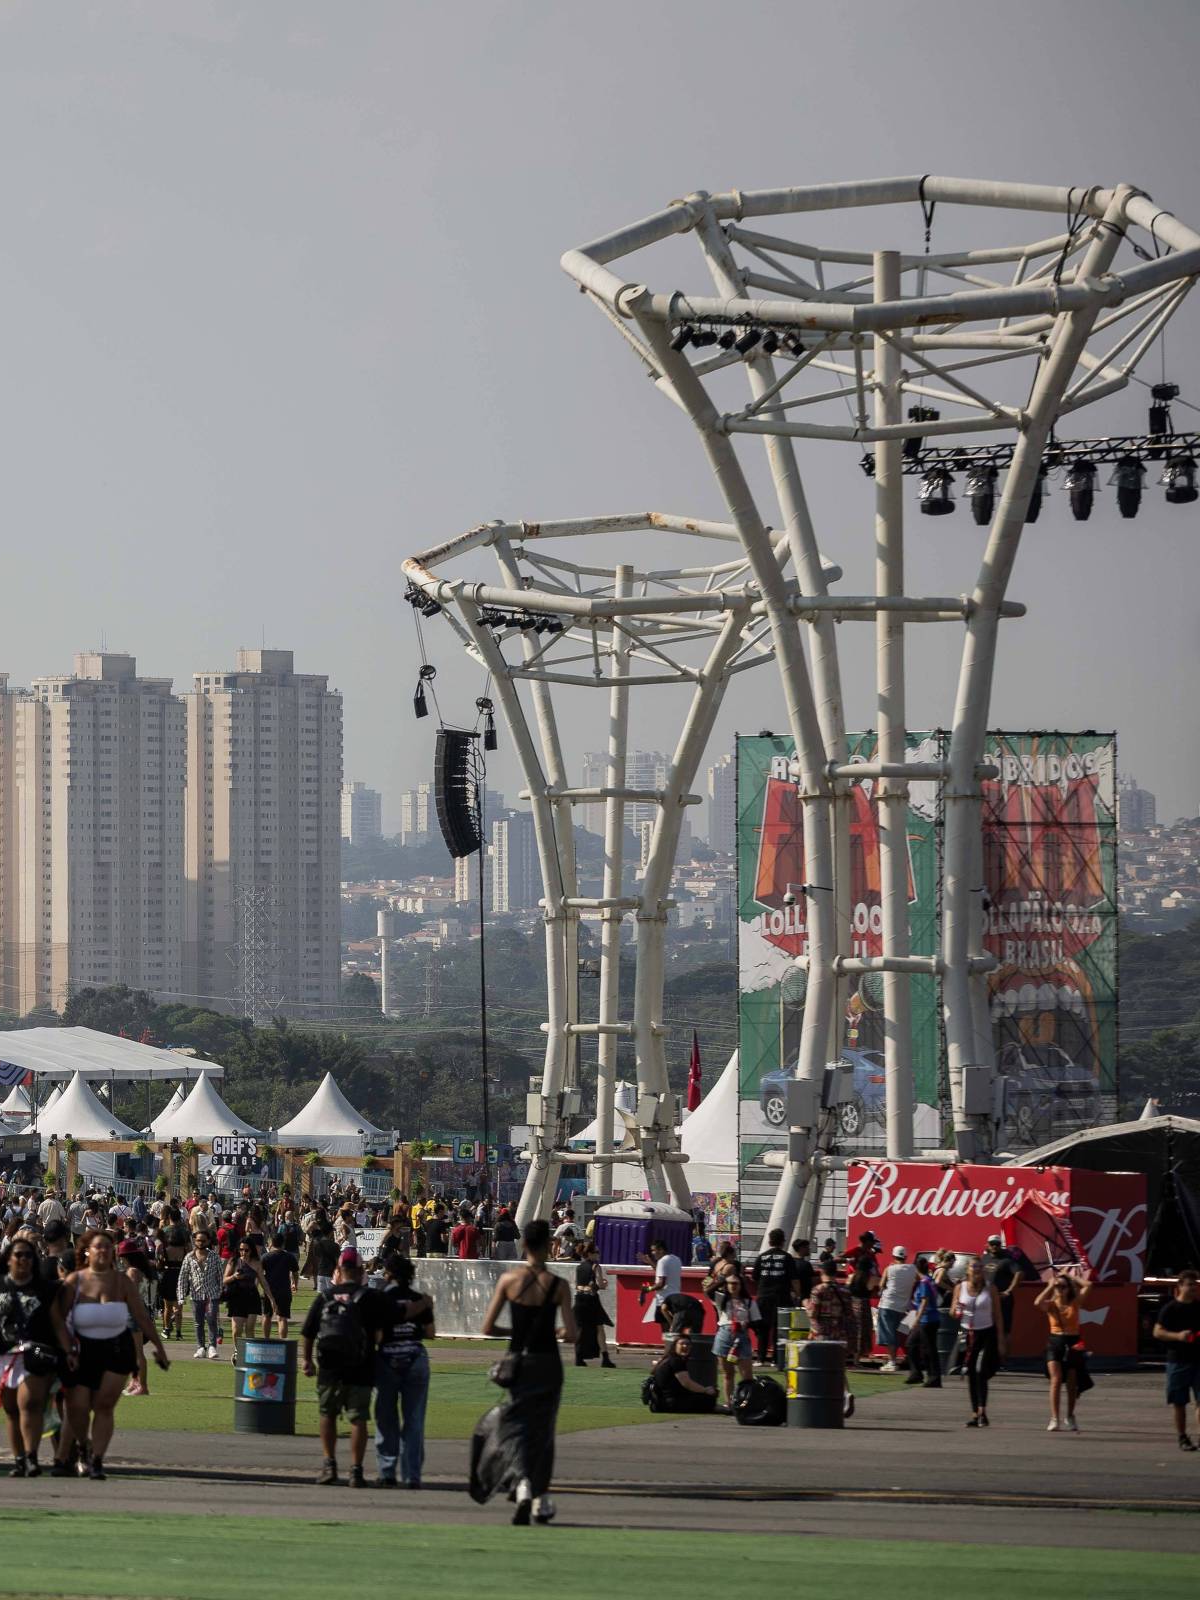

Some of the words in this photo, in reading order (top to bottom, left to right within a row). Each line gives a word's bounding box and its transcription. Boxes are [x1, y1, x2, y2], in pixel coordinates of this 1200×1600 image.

[213, 1137, 257, 1156] CHEF'S
[212, 1156, 257, 1166] STAGE
[847, 1163, 1070, 1219] Budweisr
